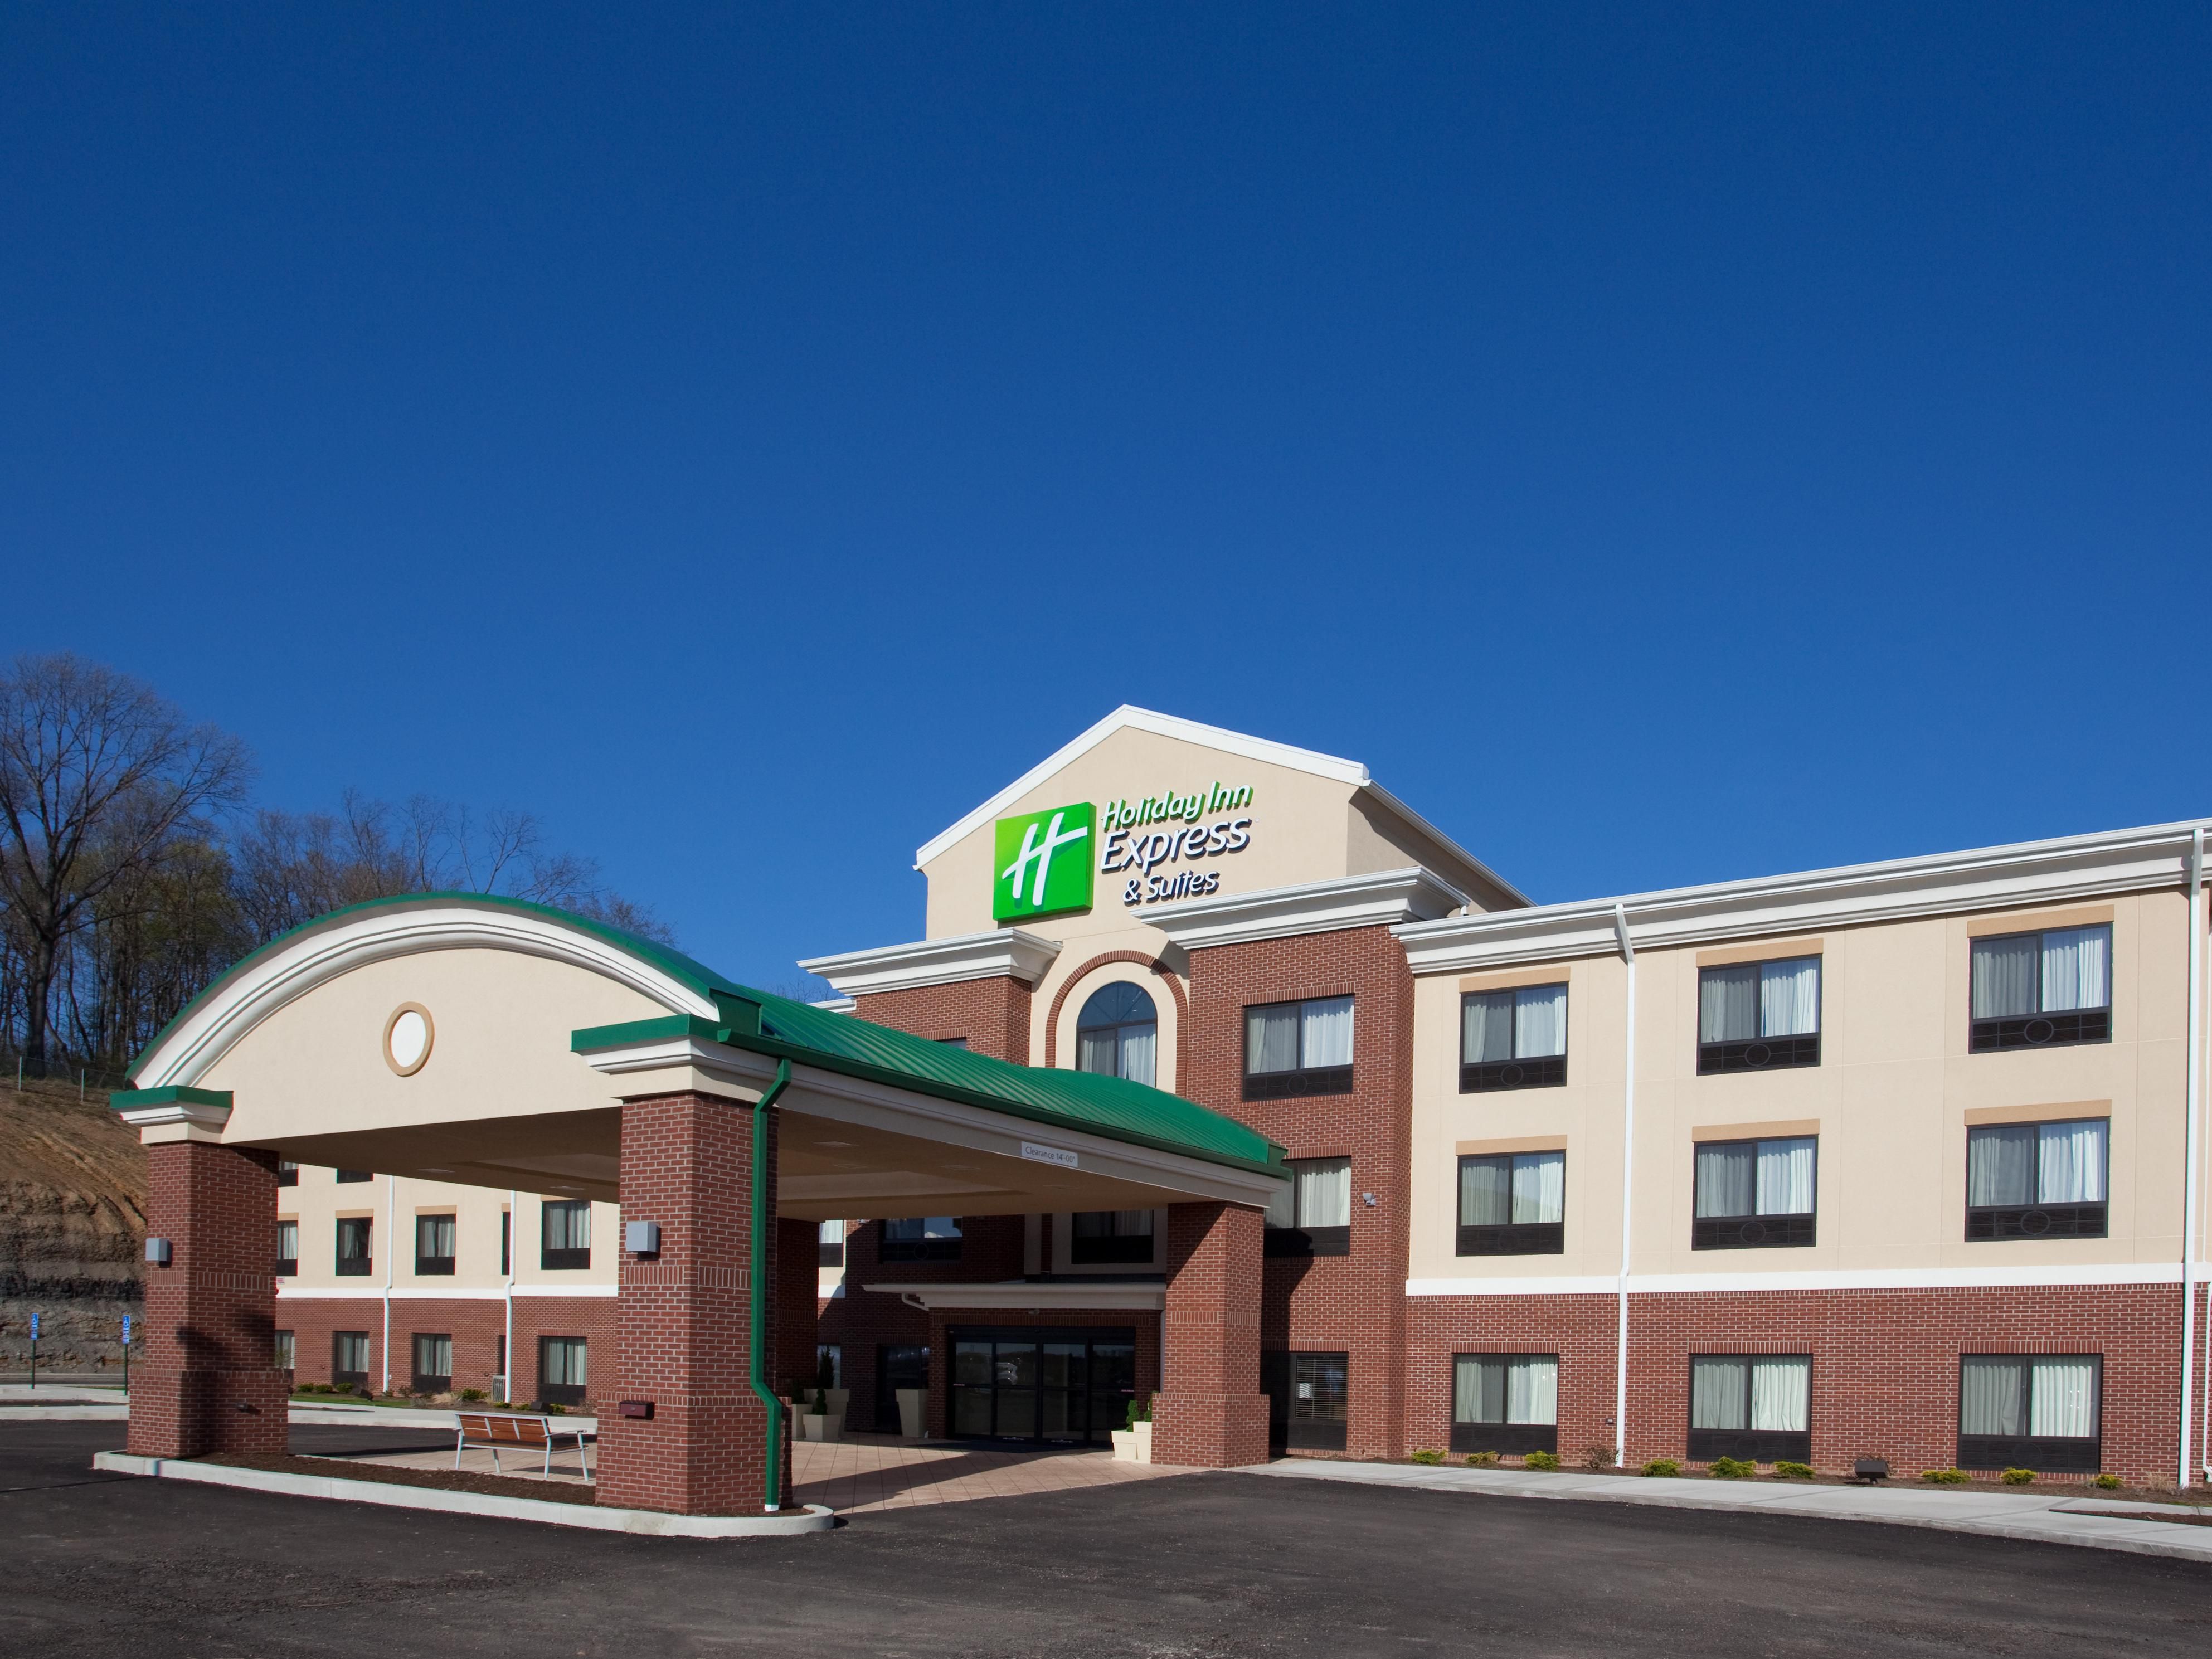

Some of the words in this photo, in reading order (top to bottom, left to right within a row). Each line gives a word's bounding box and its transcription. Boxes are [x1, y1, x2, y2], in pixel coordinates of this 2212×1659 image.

[1101, 790, 1205, 830] Holiday
[1207, 780, 1253, 810] Inn
[1099, 816, 1252, 875] Express
[1122, 878, 1142, 905] &
[1145, 870, 1220, 902] Suites
[1025, 1146, 1054, 1159] Clearance
